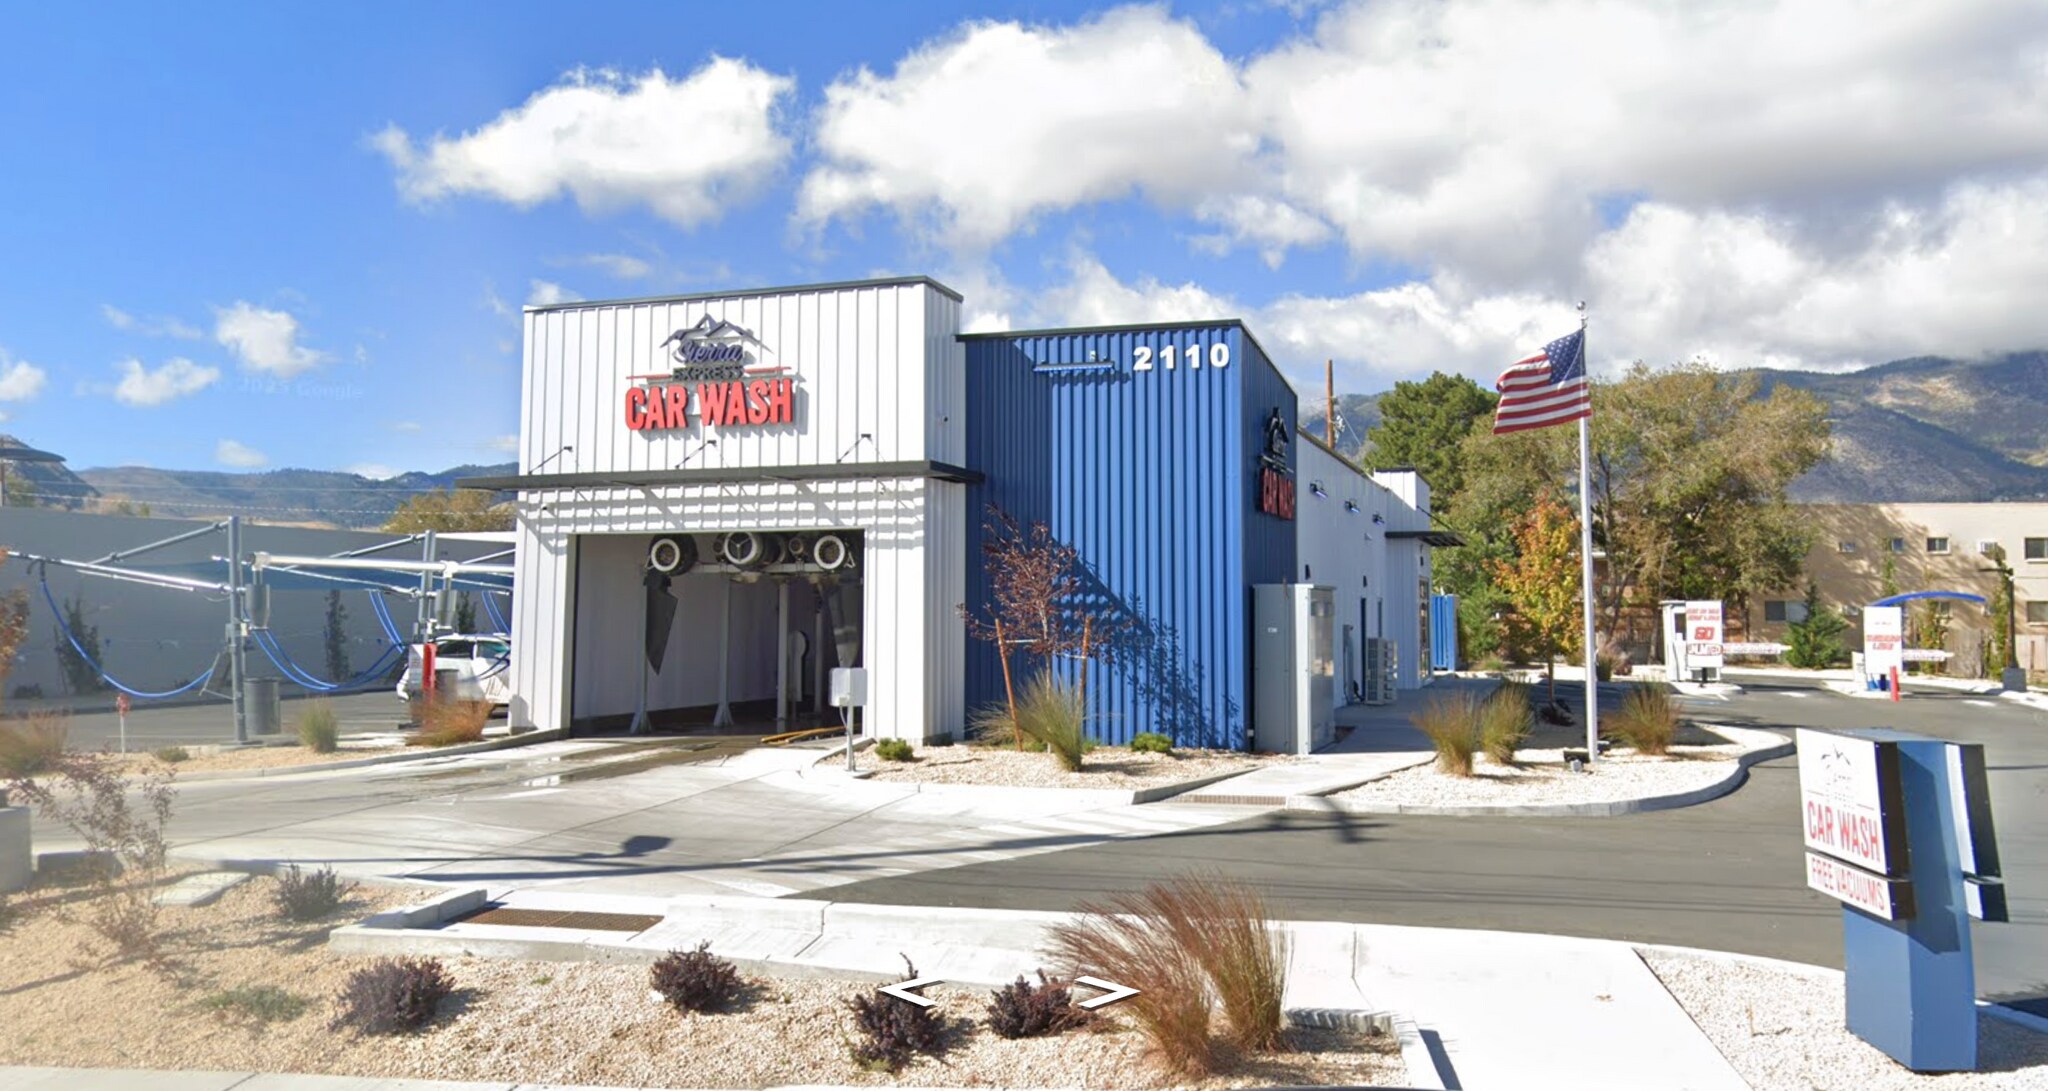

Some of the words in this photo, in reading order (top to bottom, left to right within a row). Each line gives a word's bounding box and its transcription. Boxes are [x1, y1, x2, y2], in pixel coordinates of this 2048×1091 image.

[673, 340, 744, 363] Sierra
[1133, 343, 1230, 371] 2110
[673, 365, 744, 381] EXPRESS
[625, 384, 688, 431] CAR
[697, 378, 793, 427] WASH
[1807, 801, 1835, 846] CAR
[1837, 809, 1881, 862] WASH
[1811, 857, 1835, 891] FREE
[1835, 867, 1885, 911] VACUUMS
